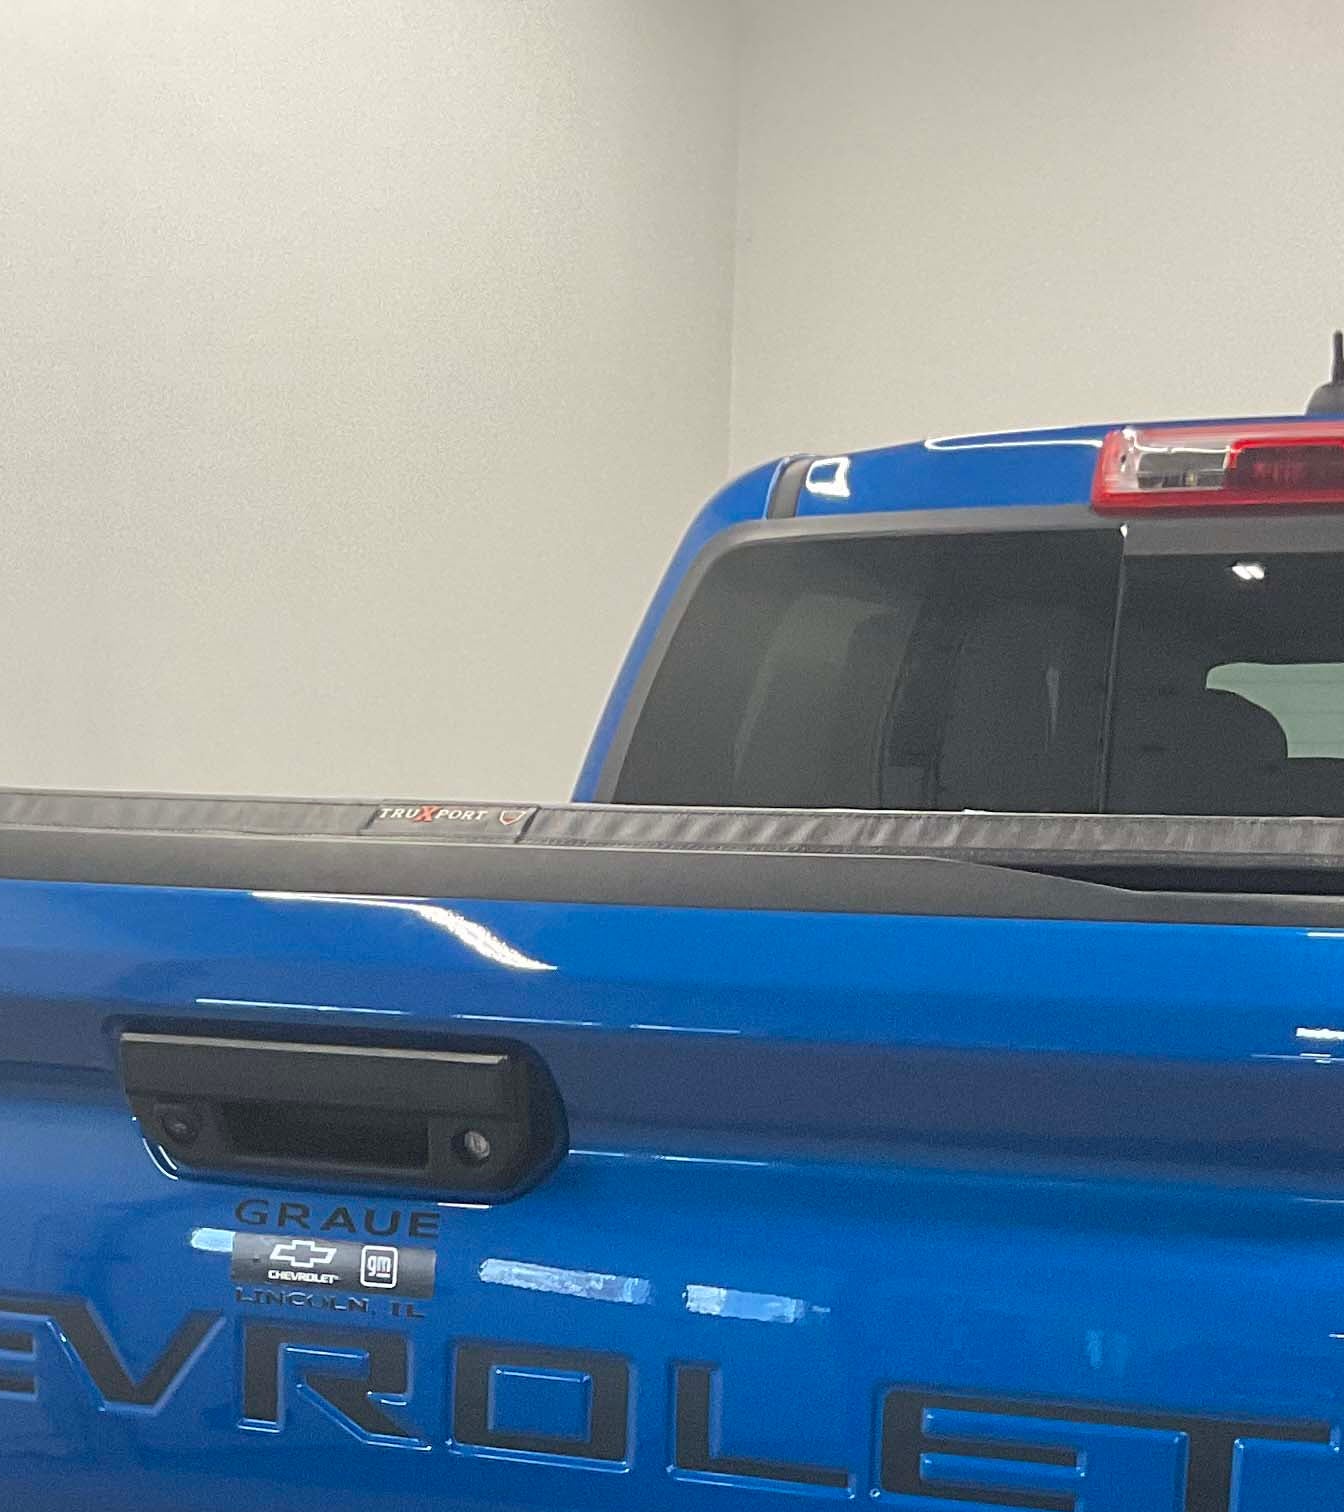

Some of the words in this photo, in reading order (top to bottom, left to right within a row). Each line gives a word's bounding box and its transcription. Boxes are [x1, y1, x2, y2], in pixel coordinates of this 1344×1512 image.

[379, 804, 488, 823] TRUXPORT
[235, 1199, 440, 1239] GRAUE
[268, 1269, 336, 1285] CHEVROLET
[367, 1255, 392, 1278] gm
